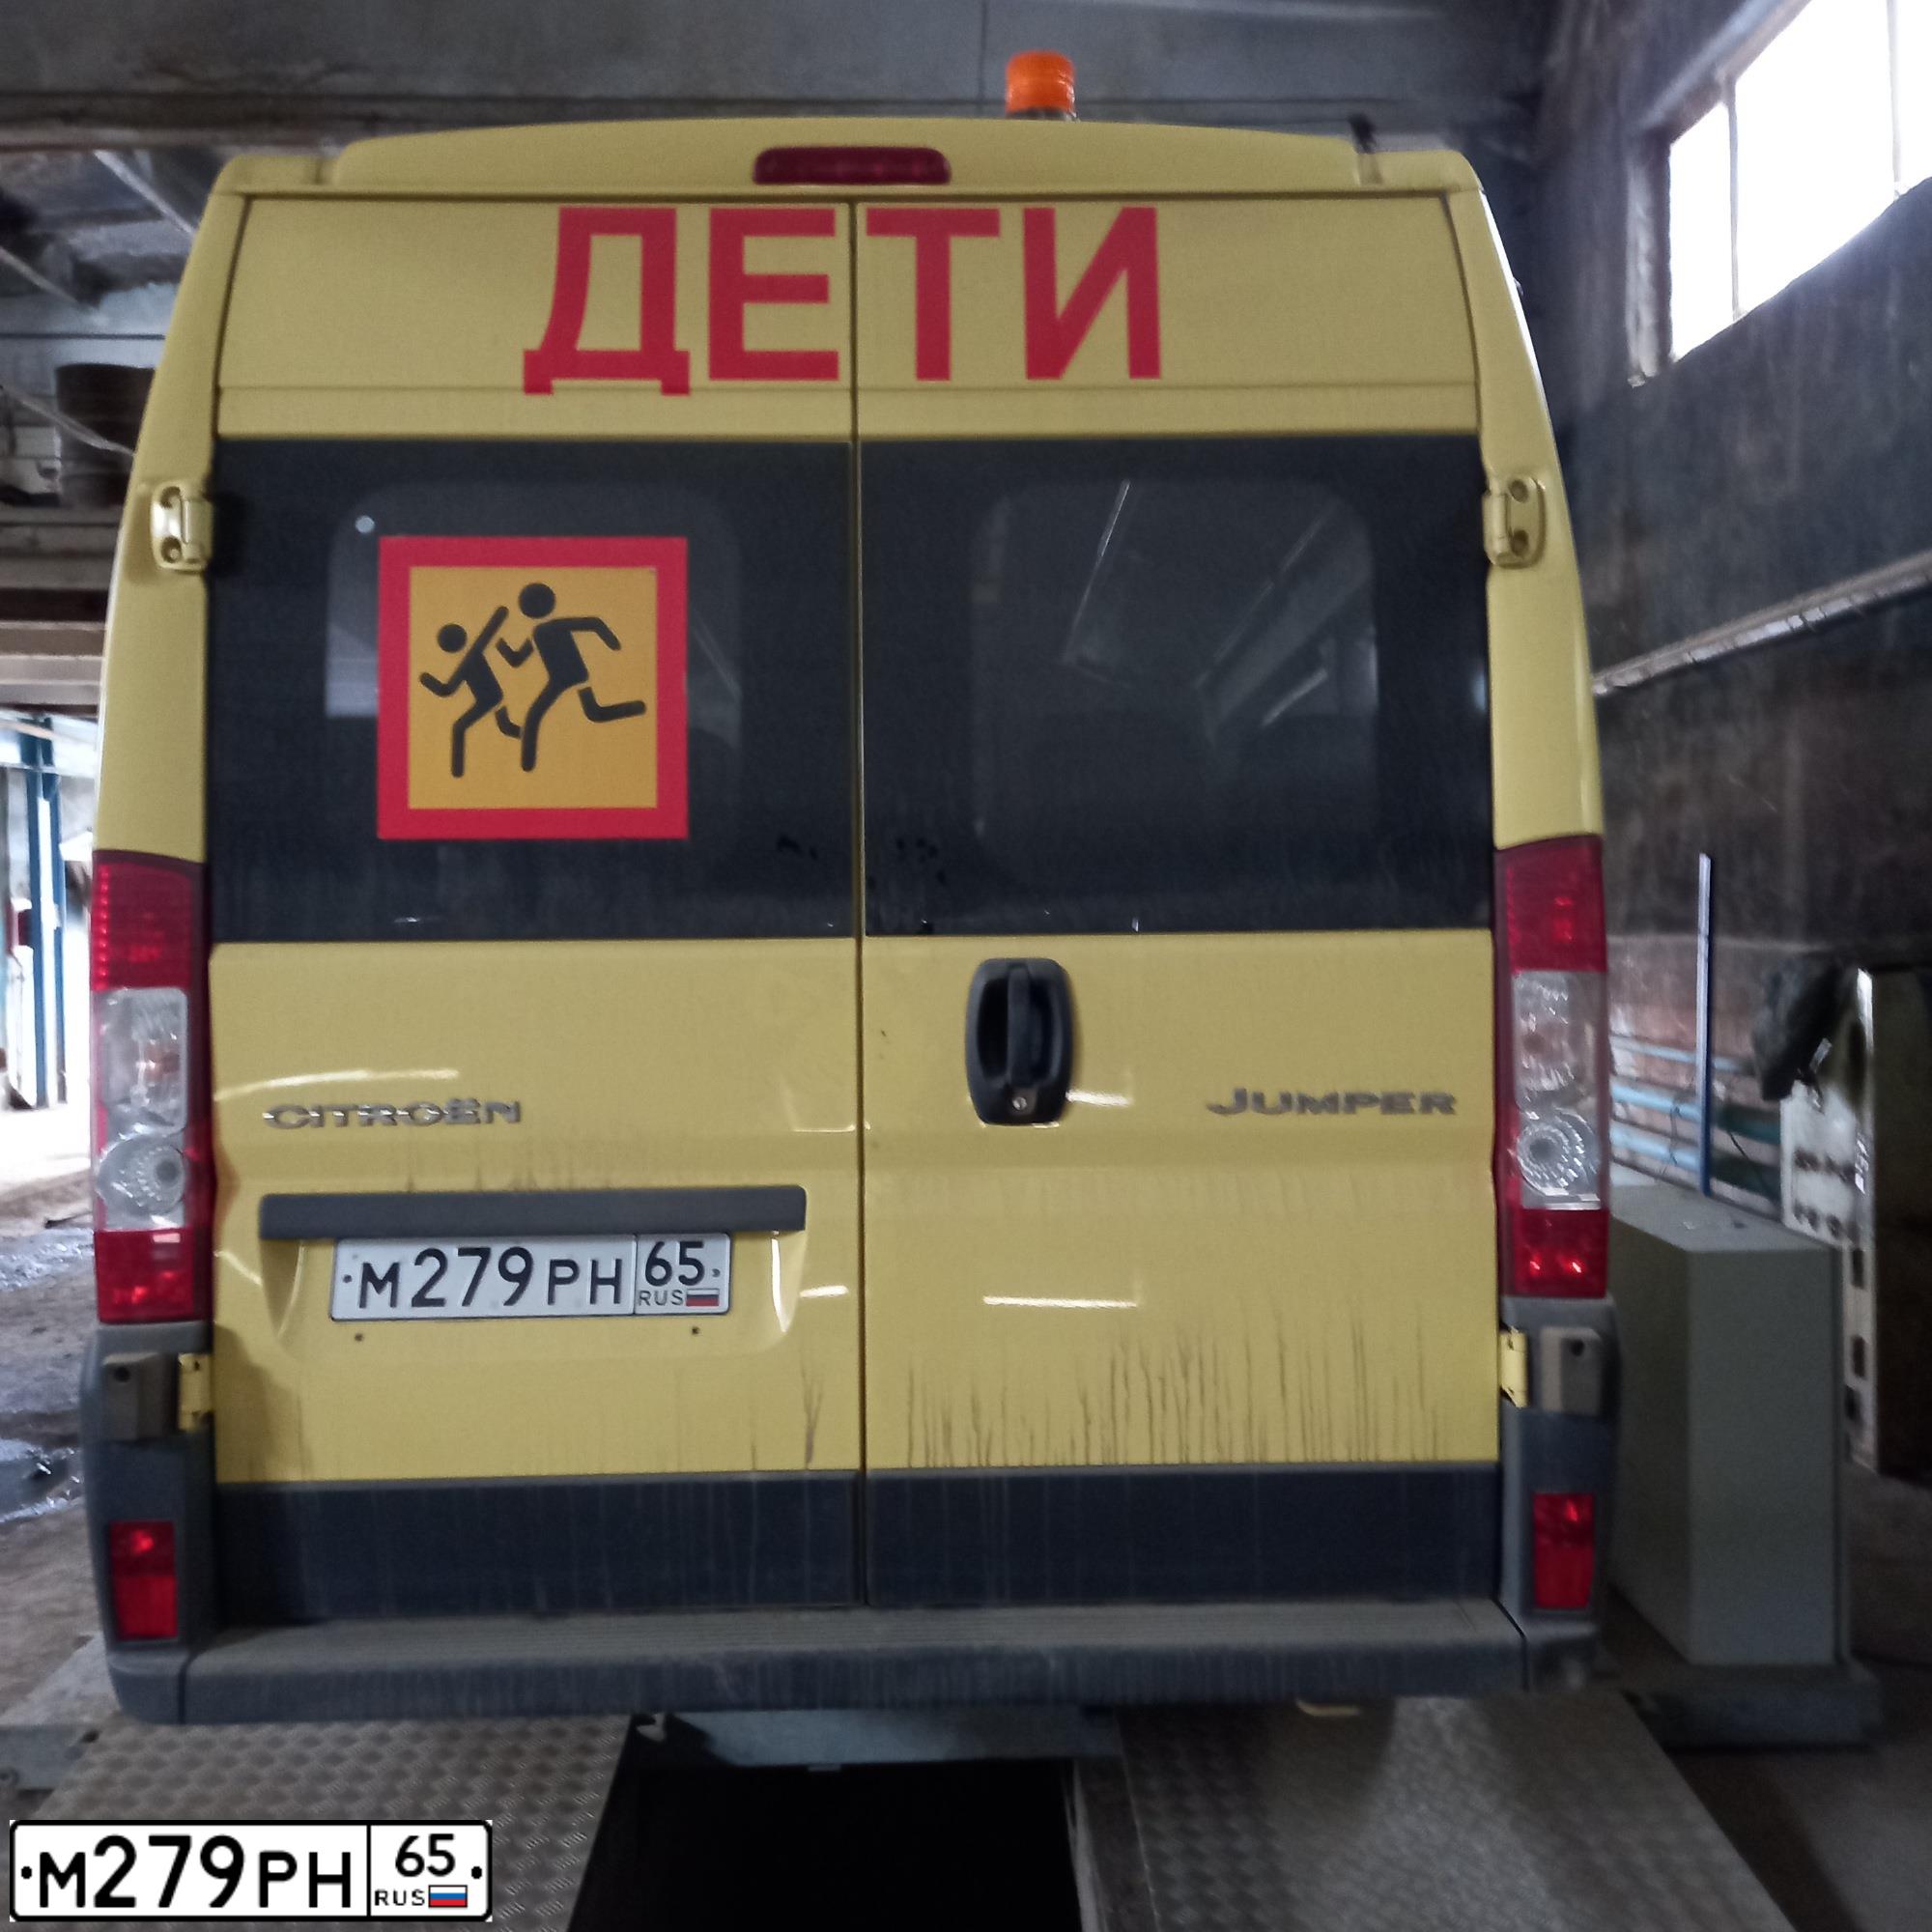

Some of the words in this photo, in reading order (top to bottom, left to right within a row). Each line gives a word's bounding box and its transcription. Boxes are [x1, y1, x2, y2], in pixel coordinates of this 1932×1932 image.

[523, 207, 1161, 396] ДЕТИ
[262, 1097, 522, 1129] CITROËN
[1207, 1088, 1458, 1116] JUMPER
[643, 1240, 705, 1287] 65
[638, 1289, 684, 1306] RUS
